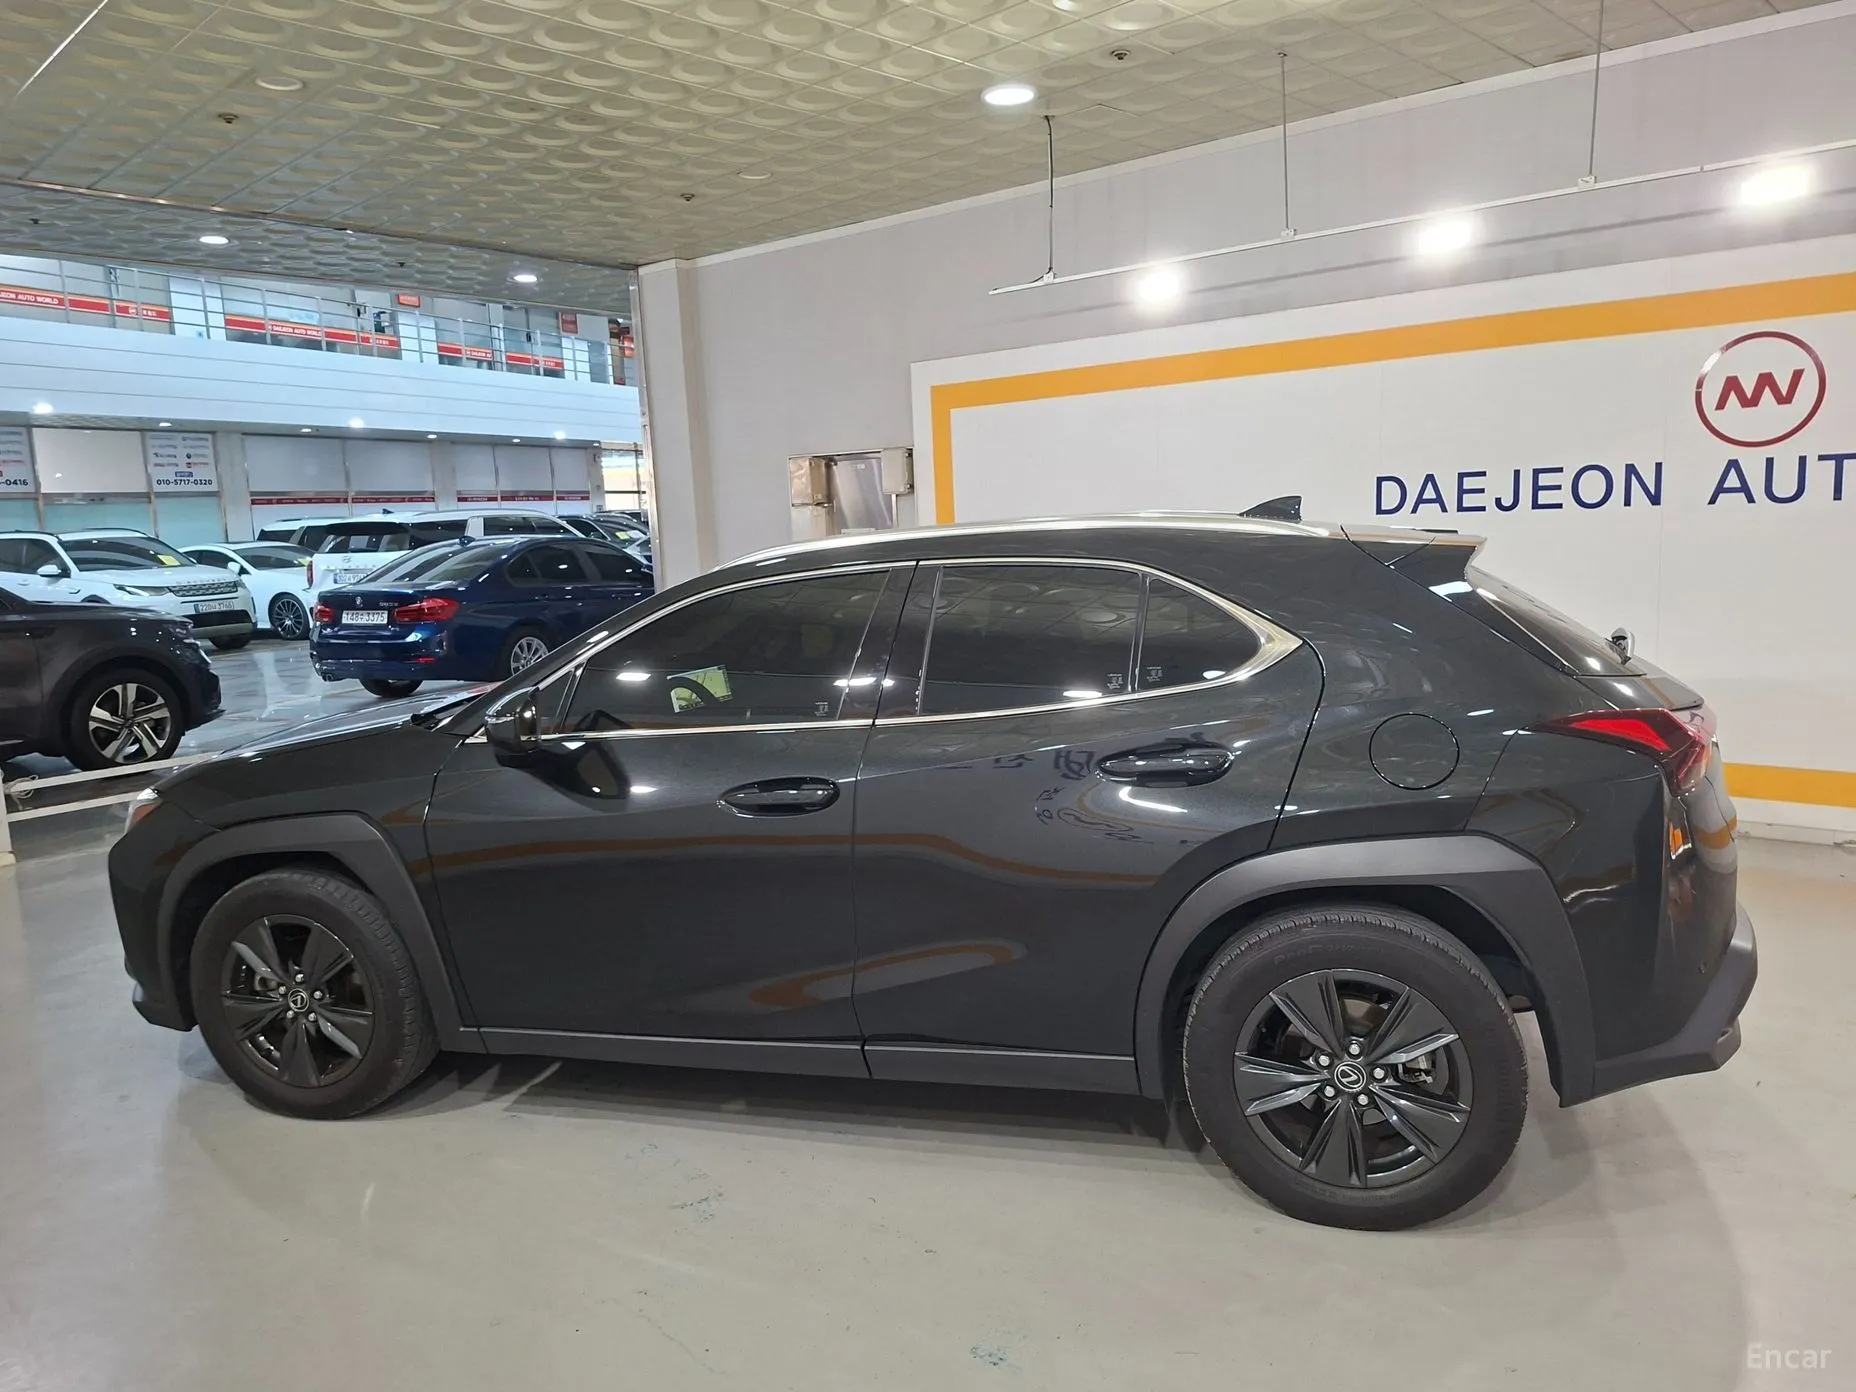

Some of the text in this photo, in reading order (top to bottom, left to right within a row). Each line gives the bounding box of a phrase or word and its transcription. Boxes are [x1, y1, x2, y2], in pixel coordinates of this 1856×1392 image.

[18, 293, 35, 302] AUTO
[36, 296, 59, 304] WORLD
[156, 478, 213, 486] 010-5717-0320
[1375, 451, 1856, 515] DAEJEON AUT
